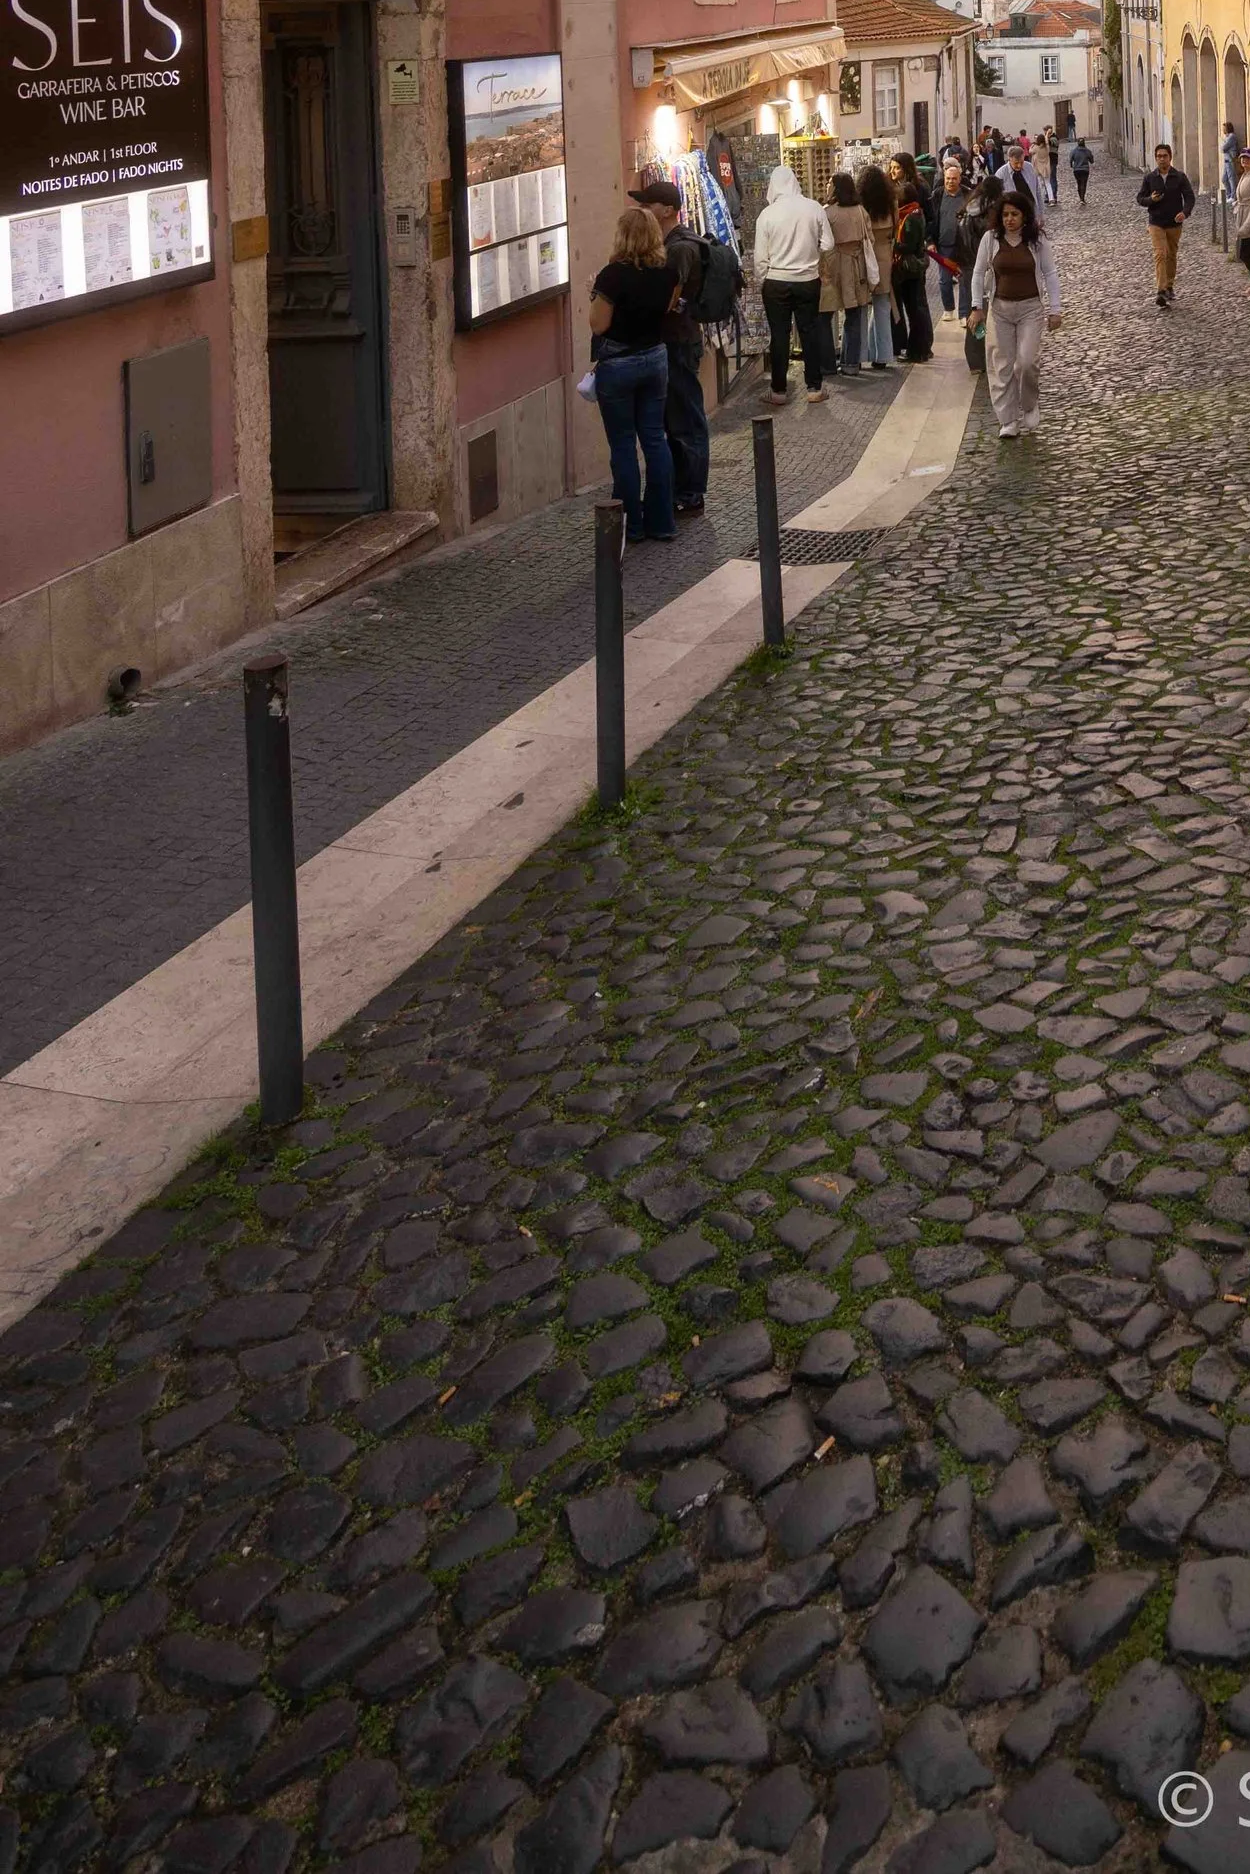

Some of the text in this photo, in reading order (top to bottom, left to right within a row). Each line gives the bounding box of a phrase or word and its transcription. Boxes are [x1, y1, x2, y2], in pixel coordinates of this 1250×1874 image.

[17, 70, 181, 99] GARRAFEIRA & PETISCOS
[476, 72, 547, 123] Terrace
[60, 96, 147, 125] WINE BAR
[61, 149, 100, 167] ANDAR
[109, 147, 124, 160] 1st
[125, 141, 158, 157] FLOOR
[22, 177, 62, 196] NOITES
[63, 175, 79, 189] DE
[80, 170, 109, 186] FADO
[119, 164, 147, 181] FADO
[148, 158, 184, 175] NIGHTS
